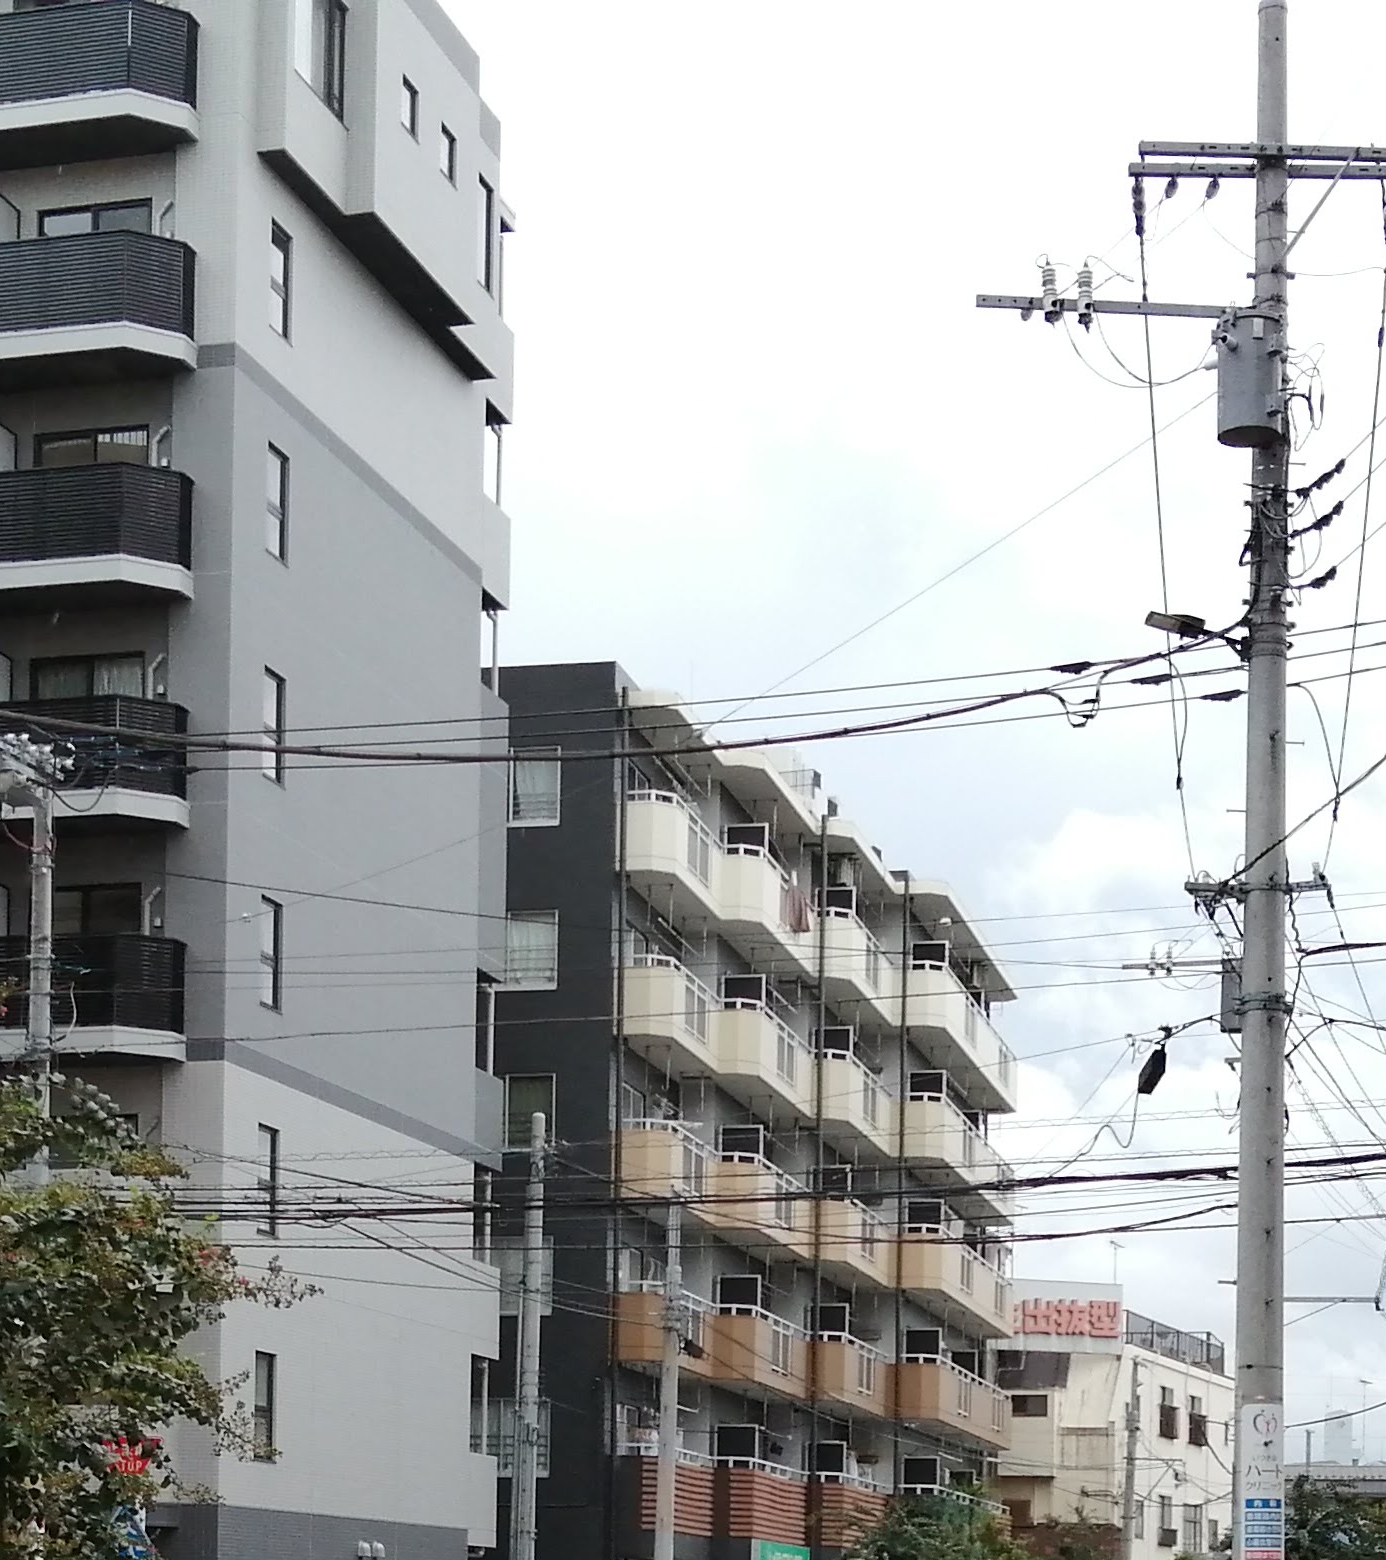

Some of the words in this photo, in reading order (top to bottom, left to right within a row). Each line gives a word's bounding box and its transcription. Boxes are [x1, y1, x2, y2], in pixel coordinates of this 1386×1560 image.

[1245, 1464, 1282, 1479] ハート
[1245, 1481, 1282, 1491] クリニック
